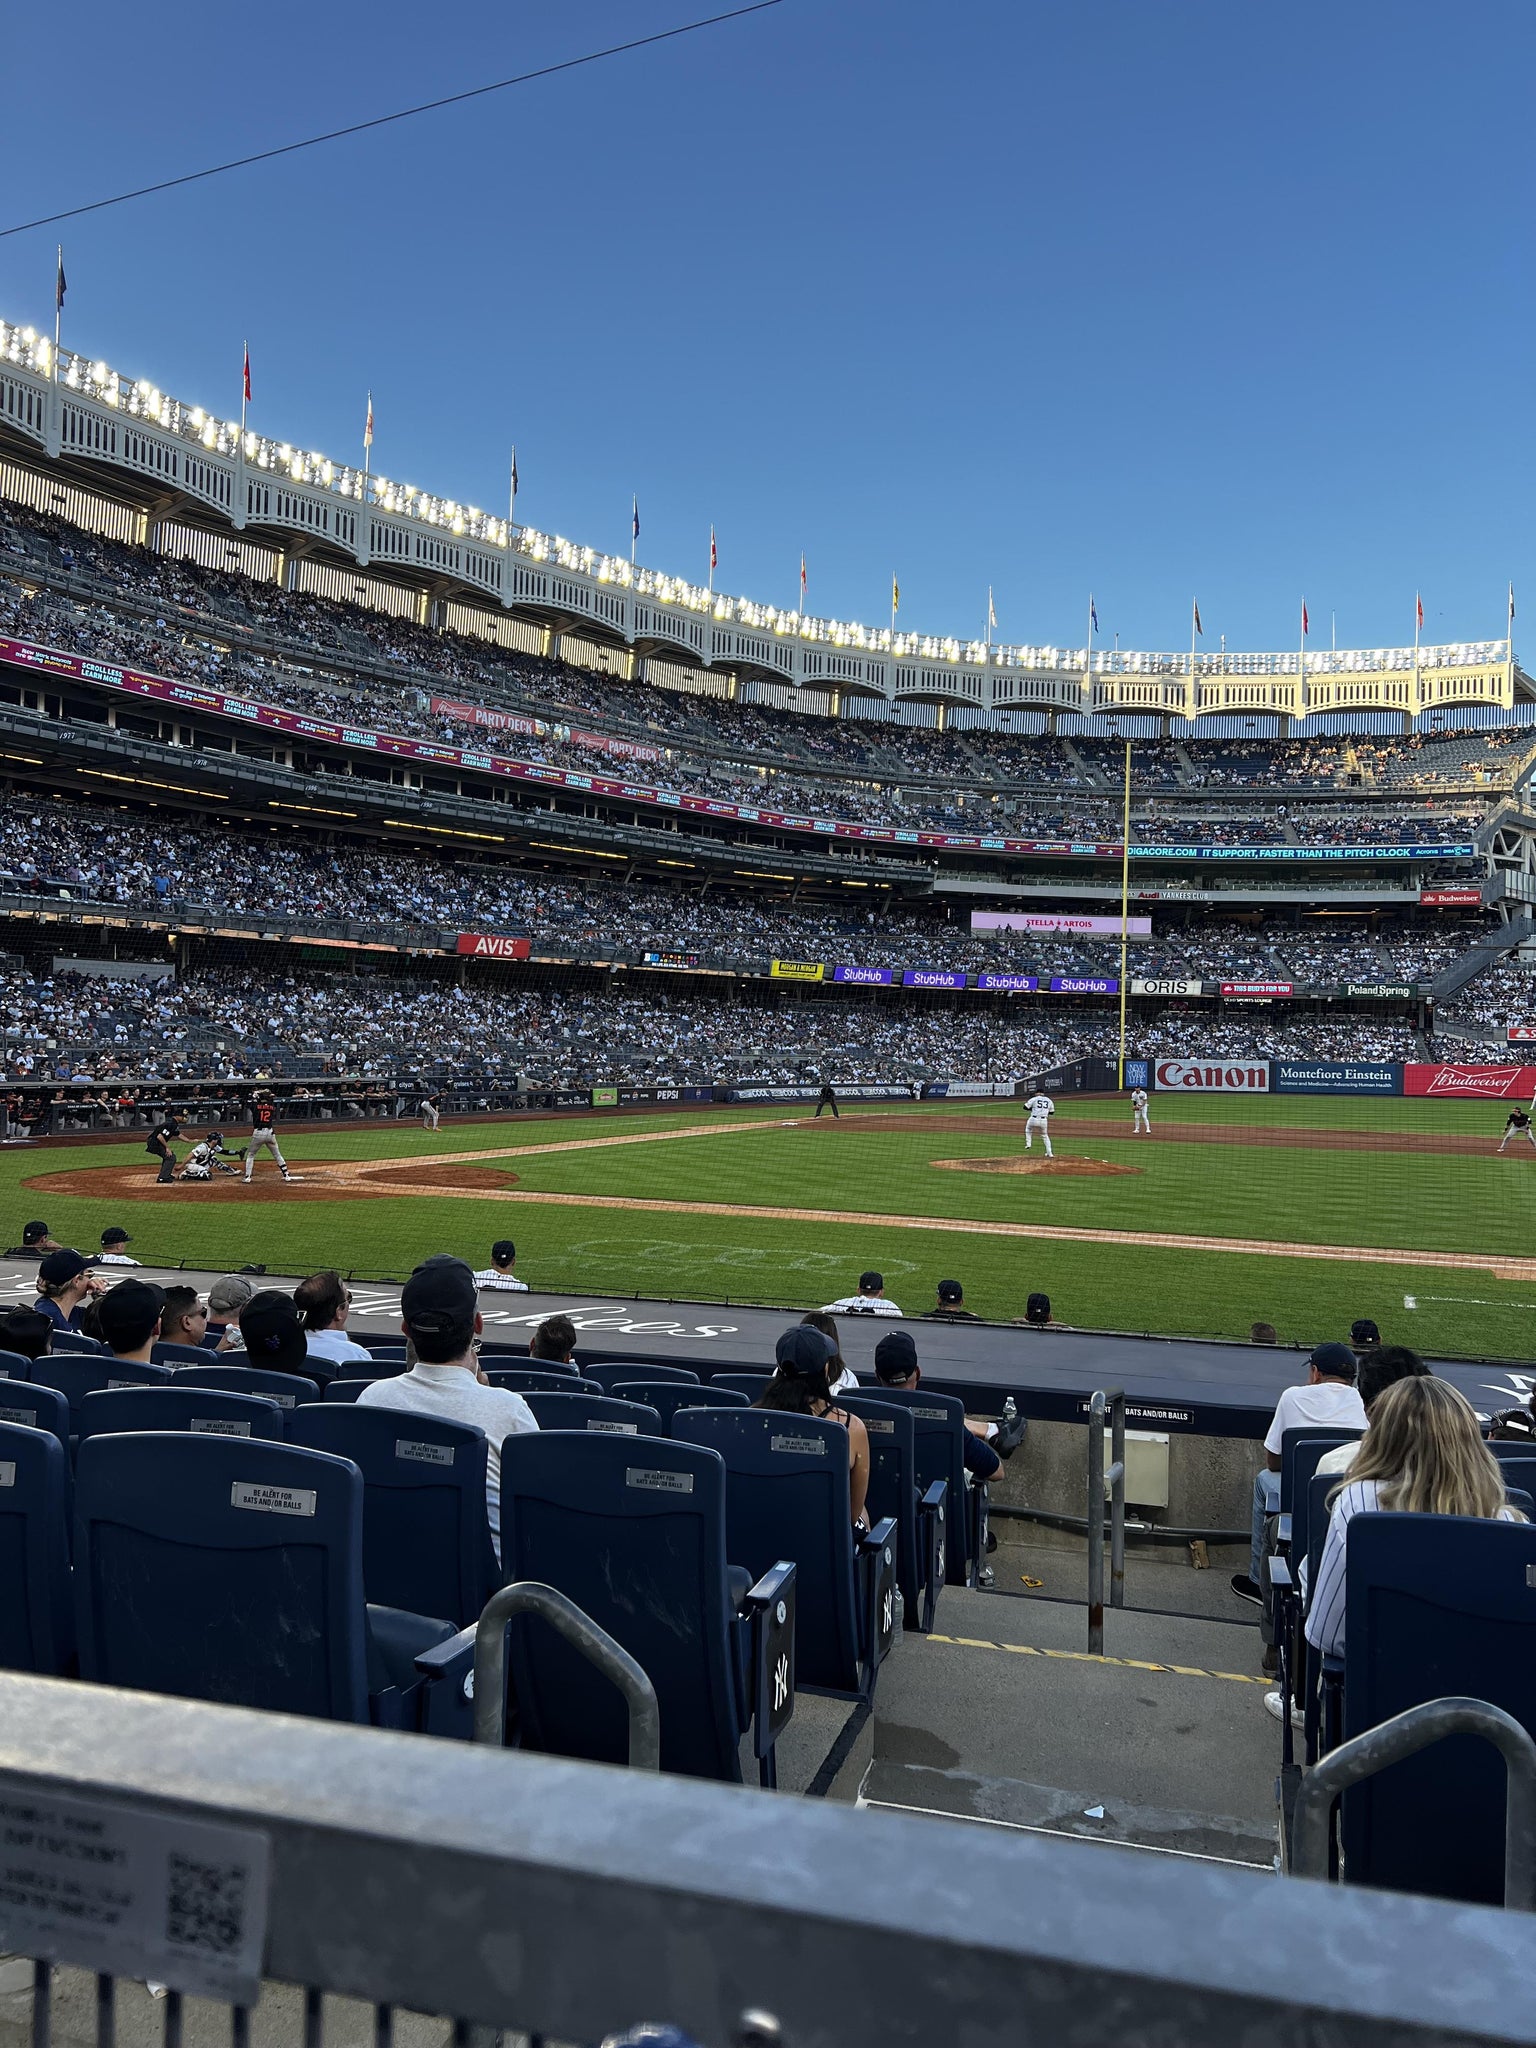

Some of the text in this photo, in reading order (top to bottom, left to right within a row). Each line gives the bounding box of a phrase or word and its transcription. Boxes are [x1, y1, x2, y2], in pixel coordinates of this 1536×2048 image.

[81, 662, 125, 679] SCROLL LESS.
[81, 669, 102, 680] LEARN
[102, 673, 124, 685] MORE.
[223, 705, 240, 714] LEARN
[241, 709, 258, 719] MORE.
[224, 699, 259, 713] SCROLL LESS.
[475, 709, 506, 727] PARTY
[507, 716, 533, 734] DECK
[342, 735, 360, 743] LEARN
[360, 738, 377, 747] MORE.
[343, 730, 378, 741] SCROLL LESS.
[609, 740, 657, 761] PARTY DECK
[1128, 847, 1197, 856] DIGACORE.COM
[1202, 849, 1410, 858] IT SUPPORT, FASTER THAN THE PITCH CLOCK
[1192, 892, 1209, 900] CLUB
[1026, 919, 1092, 928] STELLA ARTOIS
[475, 937, 514, 956] AVIS
[843, 968, 882, 982] StubHub
[913, 973, 955, 986] StubHub
[986, 976, 1030, 988] StubHub
[1061, 979, 1107, 991] StubHub
[1144, 980, 1188, 994] ORIS
[1348, 985, 1410, 997] Poland Spring
[1127, 1070, 1146, 1078] YORK
[1157, 1062, 1266, 1087] Canon
[1280, 1067, 1392, 1080] Montefiore Einstein
[1129, 1076, 1145, 1084] LIFE
[1435, 1072, 1510, 1089] Budweiser
[657, 1090, 679, 1100] PEPSI
[751, 1089, 769, 1097] COOL
[783, 1089, 800, 1097] COOL
[845, 1088, 861, 1096] COOL
[1037, 1100, 1049, 1109] 53
[260, 1110, 271, 1122] 12
[1125, 1408, 1188, 1421] BATS AND/OR BALLS
[253, 1489, 292, 1500] BE ALERT FOR
[243, 1495, 302, 1510] BATS AND/OR BALLS
